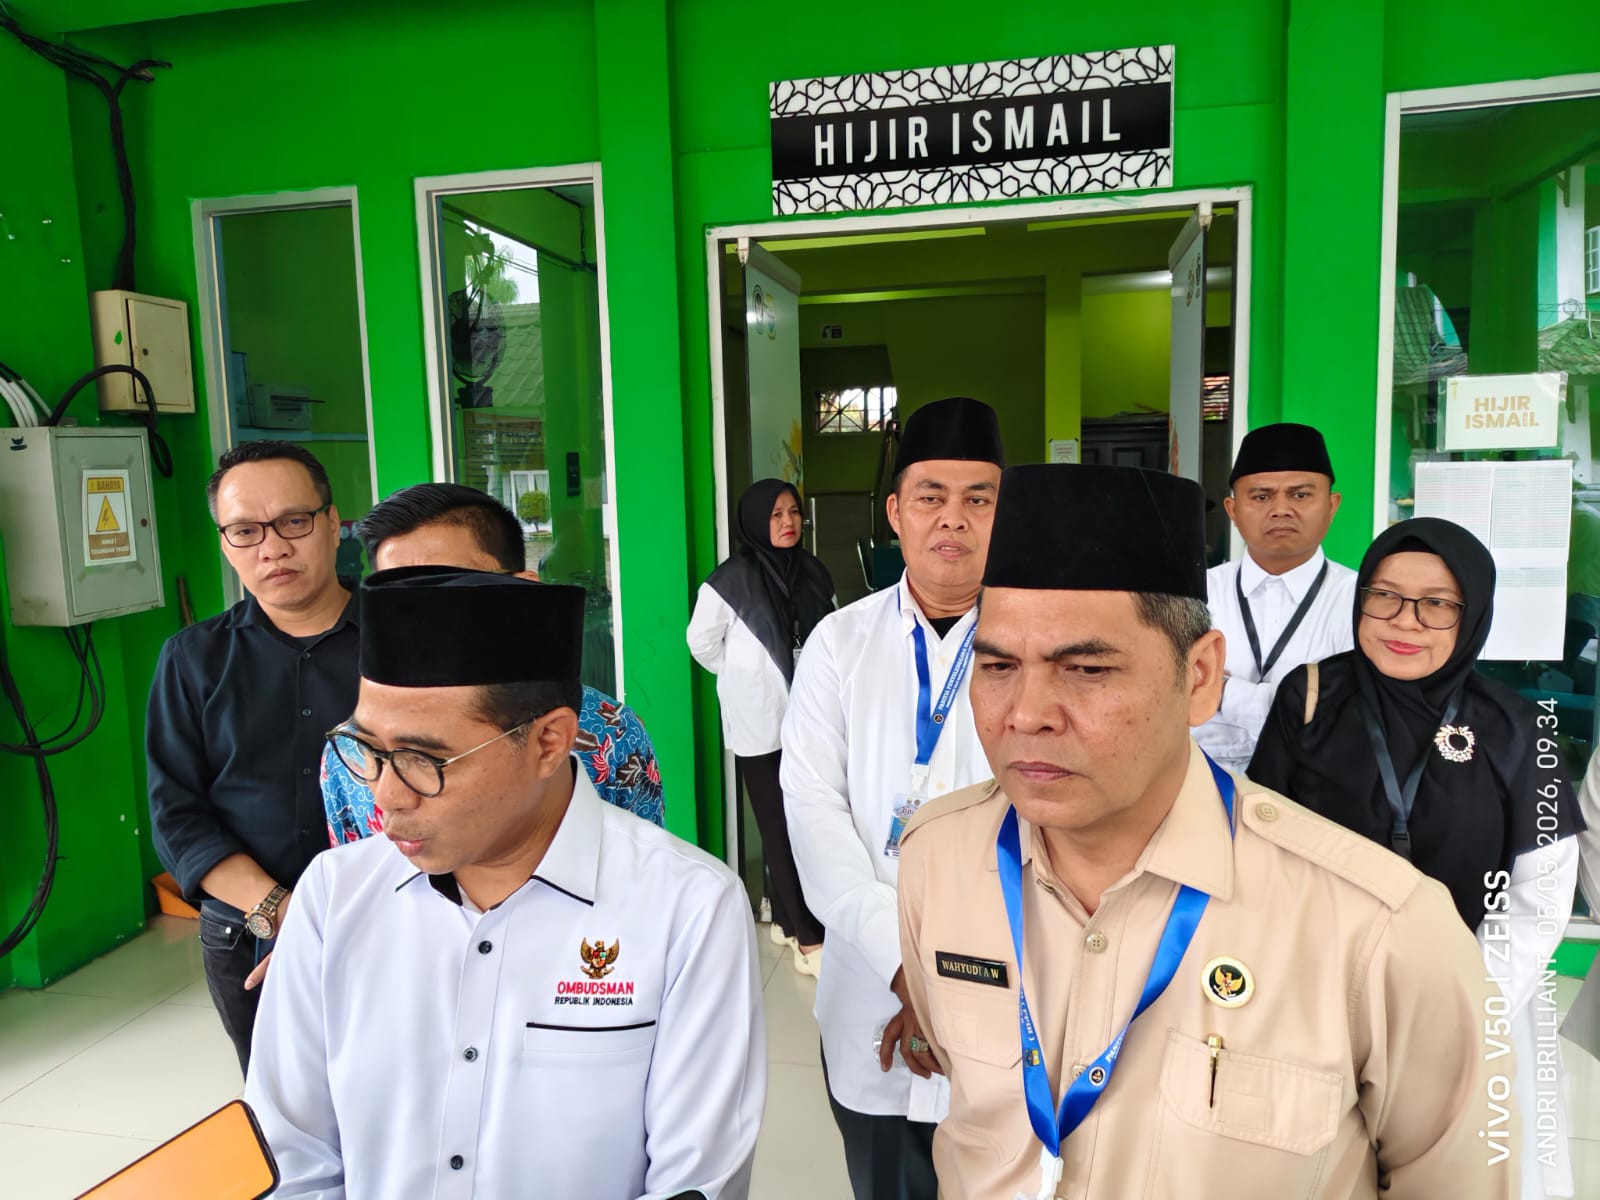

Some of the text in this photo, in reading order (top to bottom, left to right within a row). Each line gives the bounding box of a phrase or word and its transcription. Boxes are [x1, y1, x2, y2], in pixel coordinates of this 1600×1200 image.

[814, 98, 1121, 166] HIJIR ISMAIL
[1474, 395, 1531, 412] HIJIR
[1464, 412, 1540, 430] ISMAIL
[941, 960, 999, 979] WAHYUDI A W
[557, 981, 634, 995] OMBUDSMAN
[554, 996, 633, 1006] REPUBLIK INDONESIA
